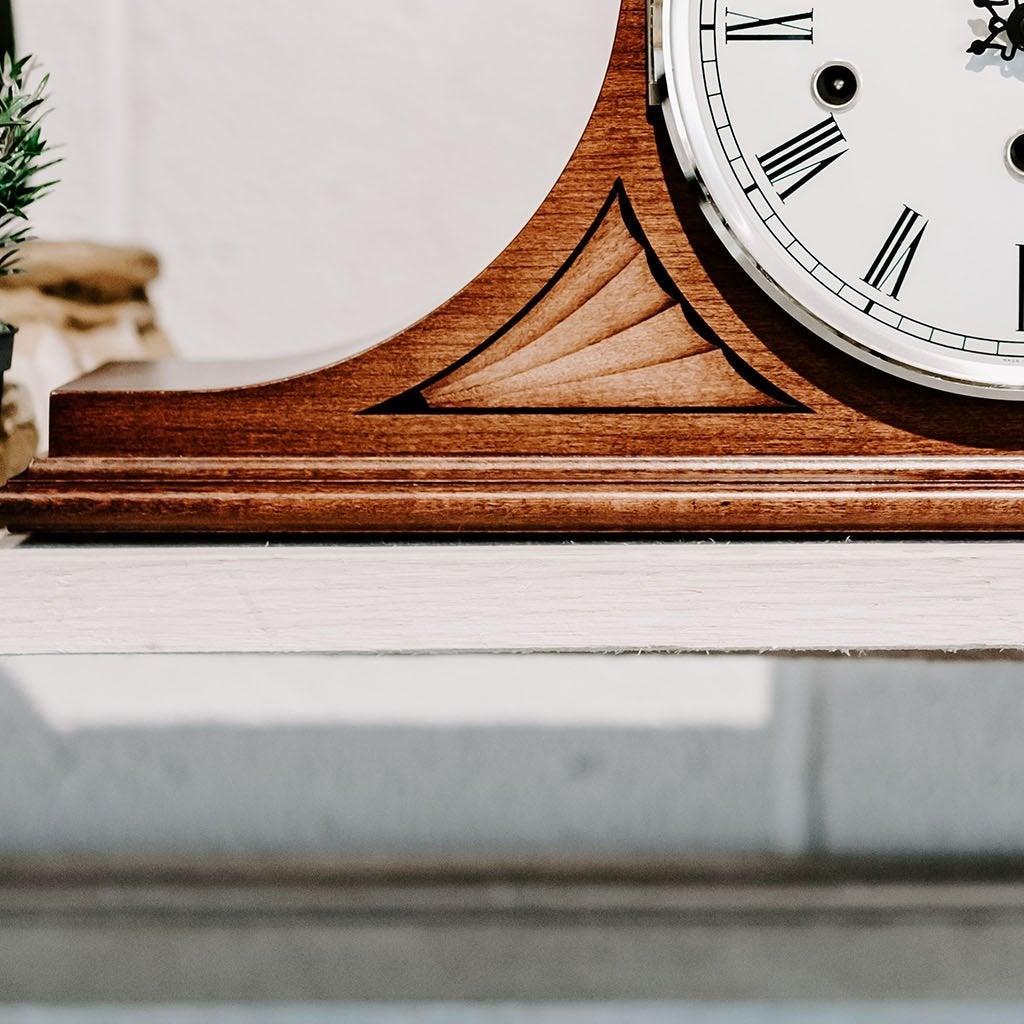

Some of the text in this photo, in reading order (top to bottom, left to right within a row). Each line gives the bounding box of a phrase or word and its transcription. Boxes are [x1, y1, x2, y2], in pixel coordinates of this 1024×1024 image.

[724, 6, 814, 45] IX
[754, 111, 850, 205] VIII
[858, 203, 930, 302] VII
